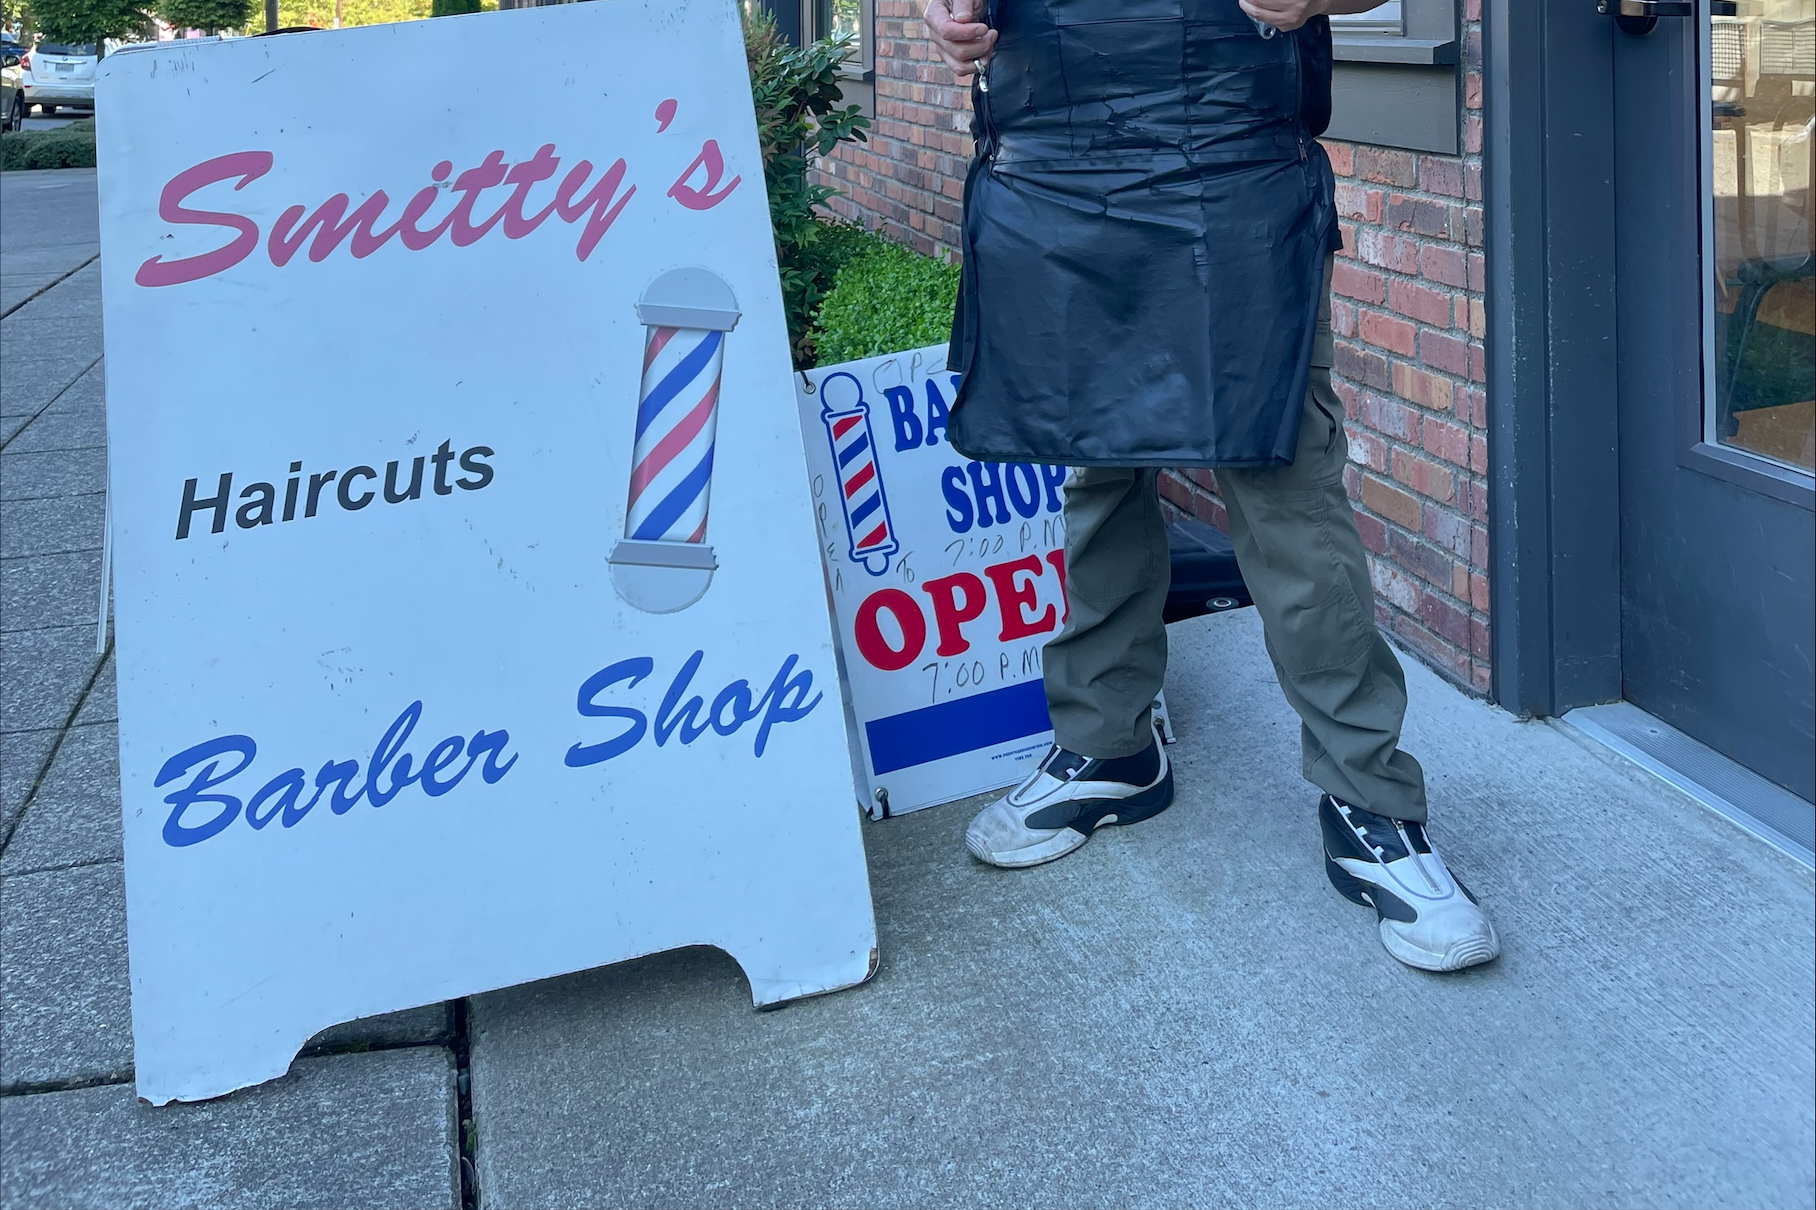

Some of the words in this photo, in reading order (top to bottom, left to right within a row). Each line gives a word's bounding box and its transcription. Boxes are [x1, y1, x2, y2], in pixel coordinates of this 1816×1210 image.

[134, 99, 741, 288] Smitty's
[884, 374, 961, 453] BA
[174, 438, 495, 539] Haircuts
[941, 460, 1066, 534] SHOP
[944, 534, 1004, 567] 7:00
[922, 660, 985, 703] 7:00
[154, 700, 519, 848] Barber
[564, 648, 822, 769] Shop
